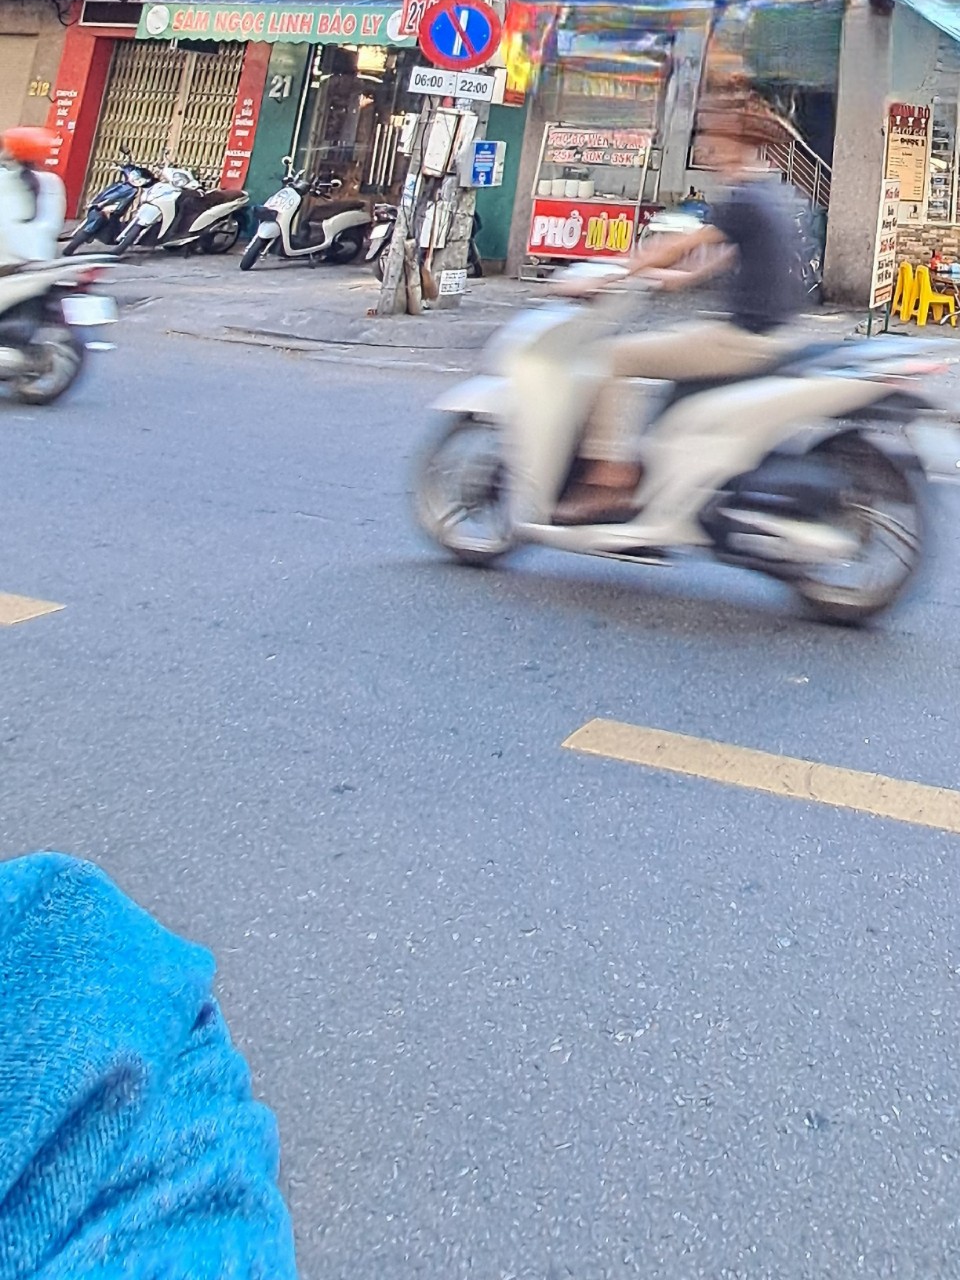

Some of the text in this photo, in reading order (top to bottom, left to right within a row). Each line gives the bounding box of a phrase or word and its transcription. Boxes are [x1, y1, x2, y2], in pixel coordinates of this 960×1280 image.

[214, 11, 265, 39] NGỌC
[268, 12, 313, 34] LINH
[317, 8, 356, 34] BẢO
[360, 13, 383, 36] LY
[269, 75, 292, 99] 21
[414, 73, 444, 89] 06:00
[459, 79, 489, 95] 22:00
[531, 210, 583, 249] PHỞ
